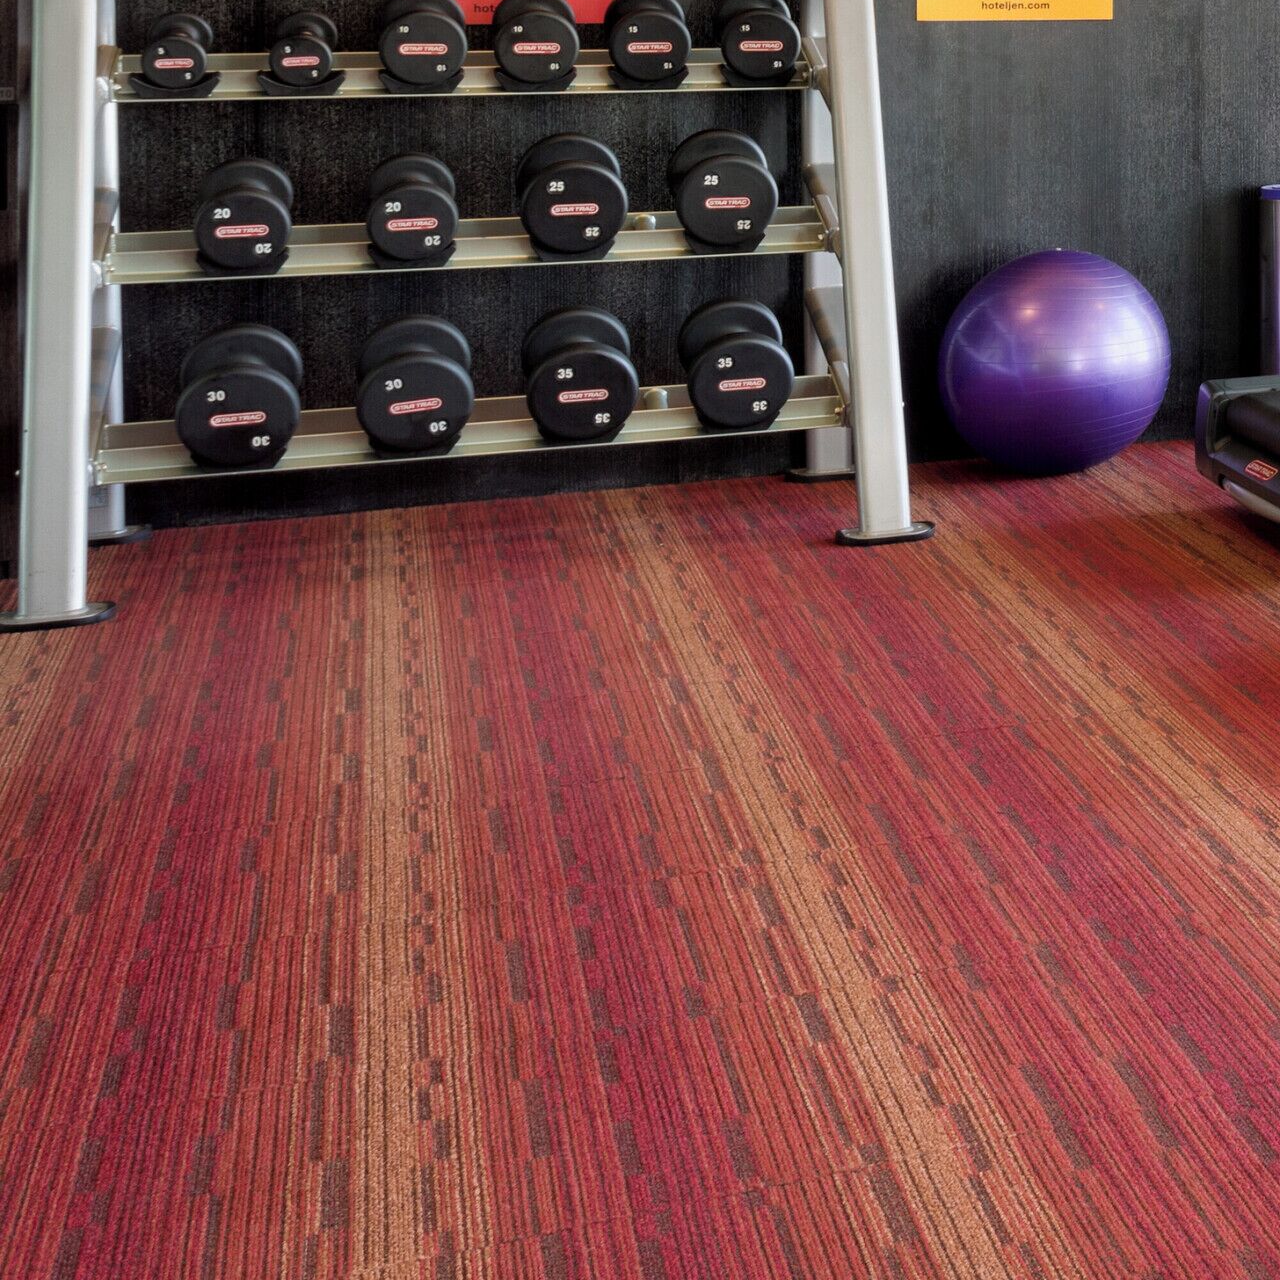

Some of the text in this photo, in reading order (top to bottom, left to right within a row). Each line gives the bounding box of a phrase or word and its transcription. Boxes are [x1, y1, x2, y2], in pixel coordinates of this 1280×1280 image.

[981, 0, 1050, 10] hoteljen.com
[399, 25, 409, 33] 10
[513, 25, 524, 33] 10
[628, 25, 638, 33] 15
[741, 24, 750, 32] 15
[703, 175, 719, 185] 25
[549, 181, 565, 192] 25
[385, 202, 402, 212] 20
[213, 208, 231, 219] 20
[717, 357, 733, 368] 35
[557, 368, 574, 379] 35
[385, 378, 403, 390] 30
[206, 390, 226, 402] 30
